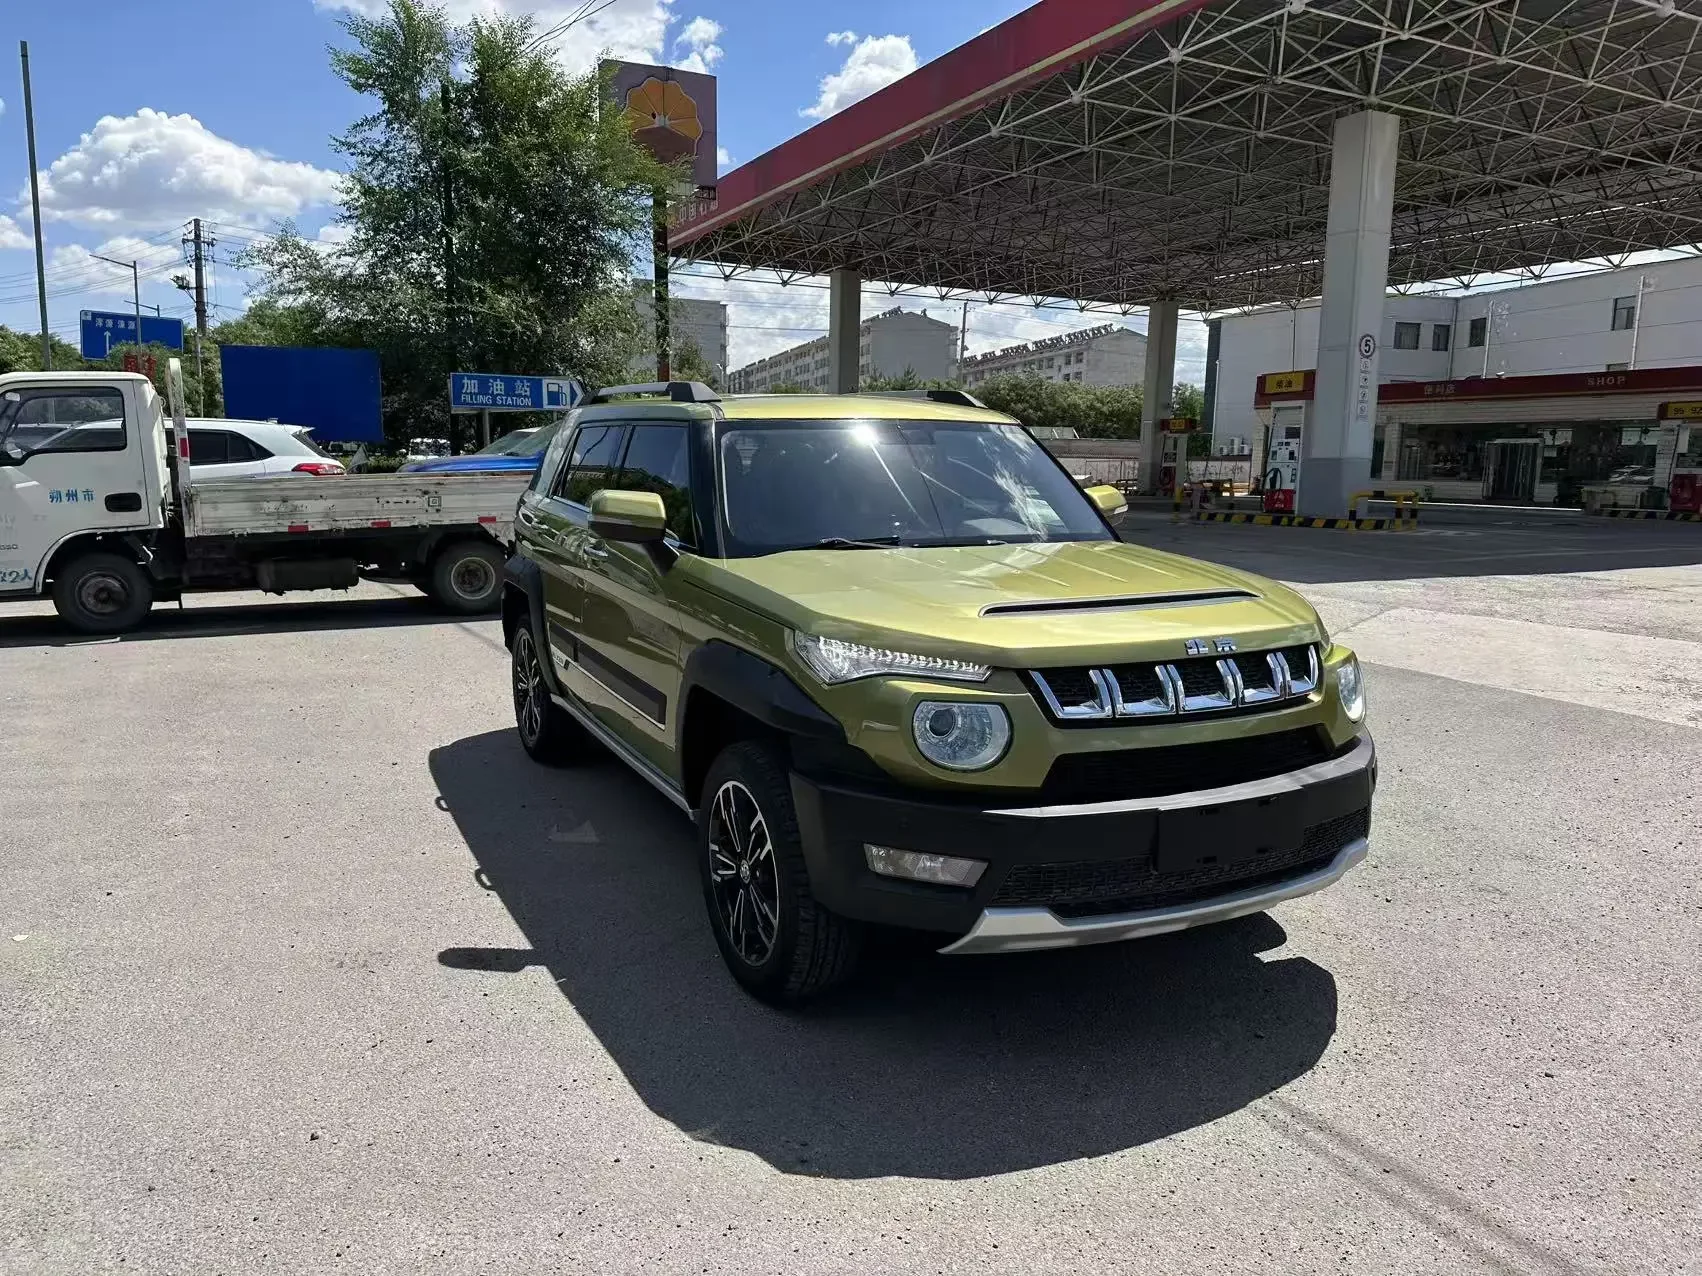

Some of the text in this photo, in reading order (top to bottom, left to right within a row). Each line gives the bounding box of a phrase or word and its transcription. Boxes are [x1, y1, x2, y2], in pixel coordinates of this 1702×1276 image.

[462, 376, 531, 396] 加油站
[1587, 375, 1626, 386] SHOP
[461, 394, 531, 406] FILLING STATION
[49, 488, 94, 503] 朔州市
[1184, 637, 1237, 655] 北京
